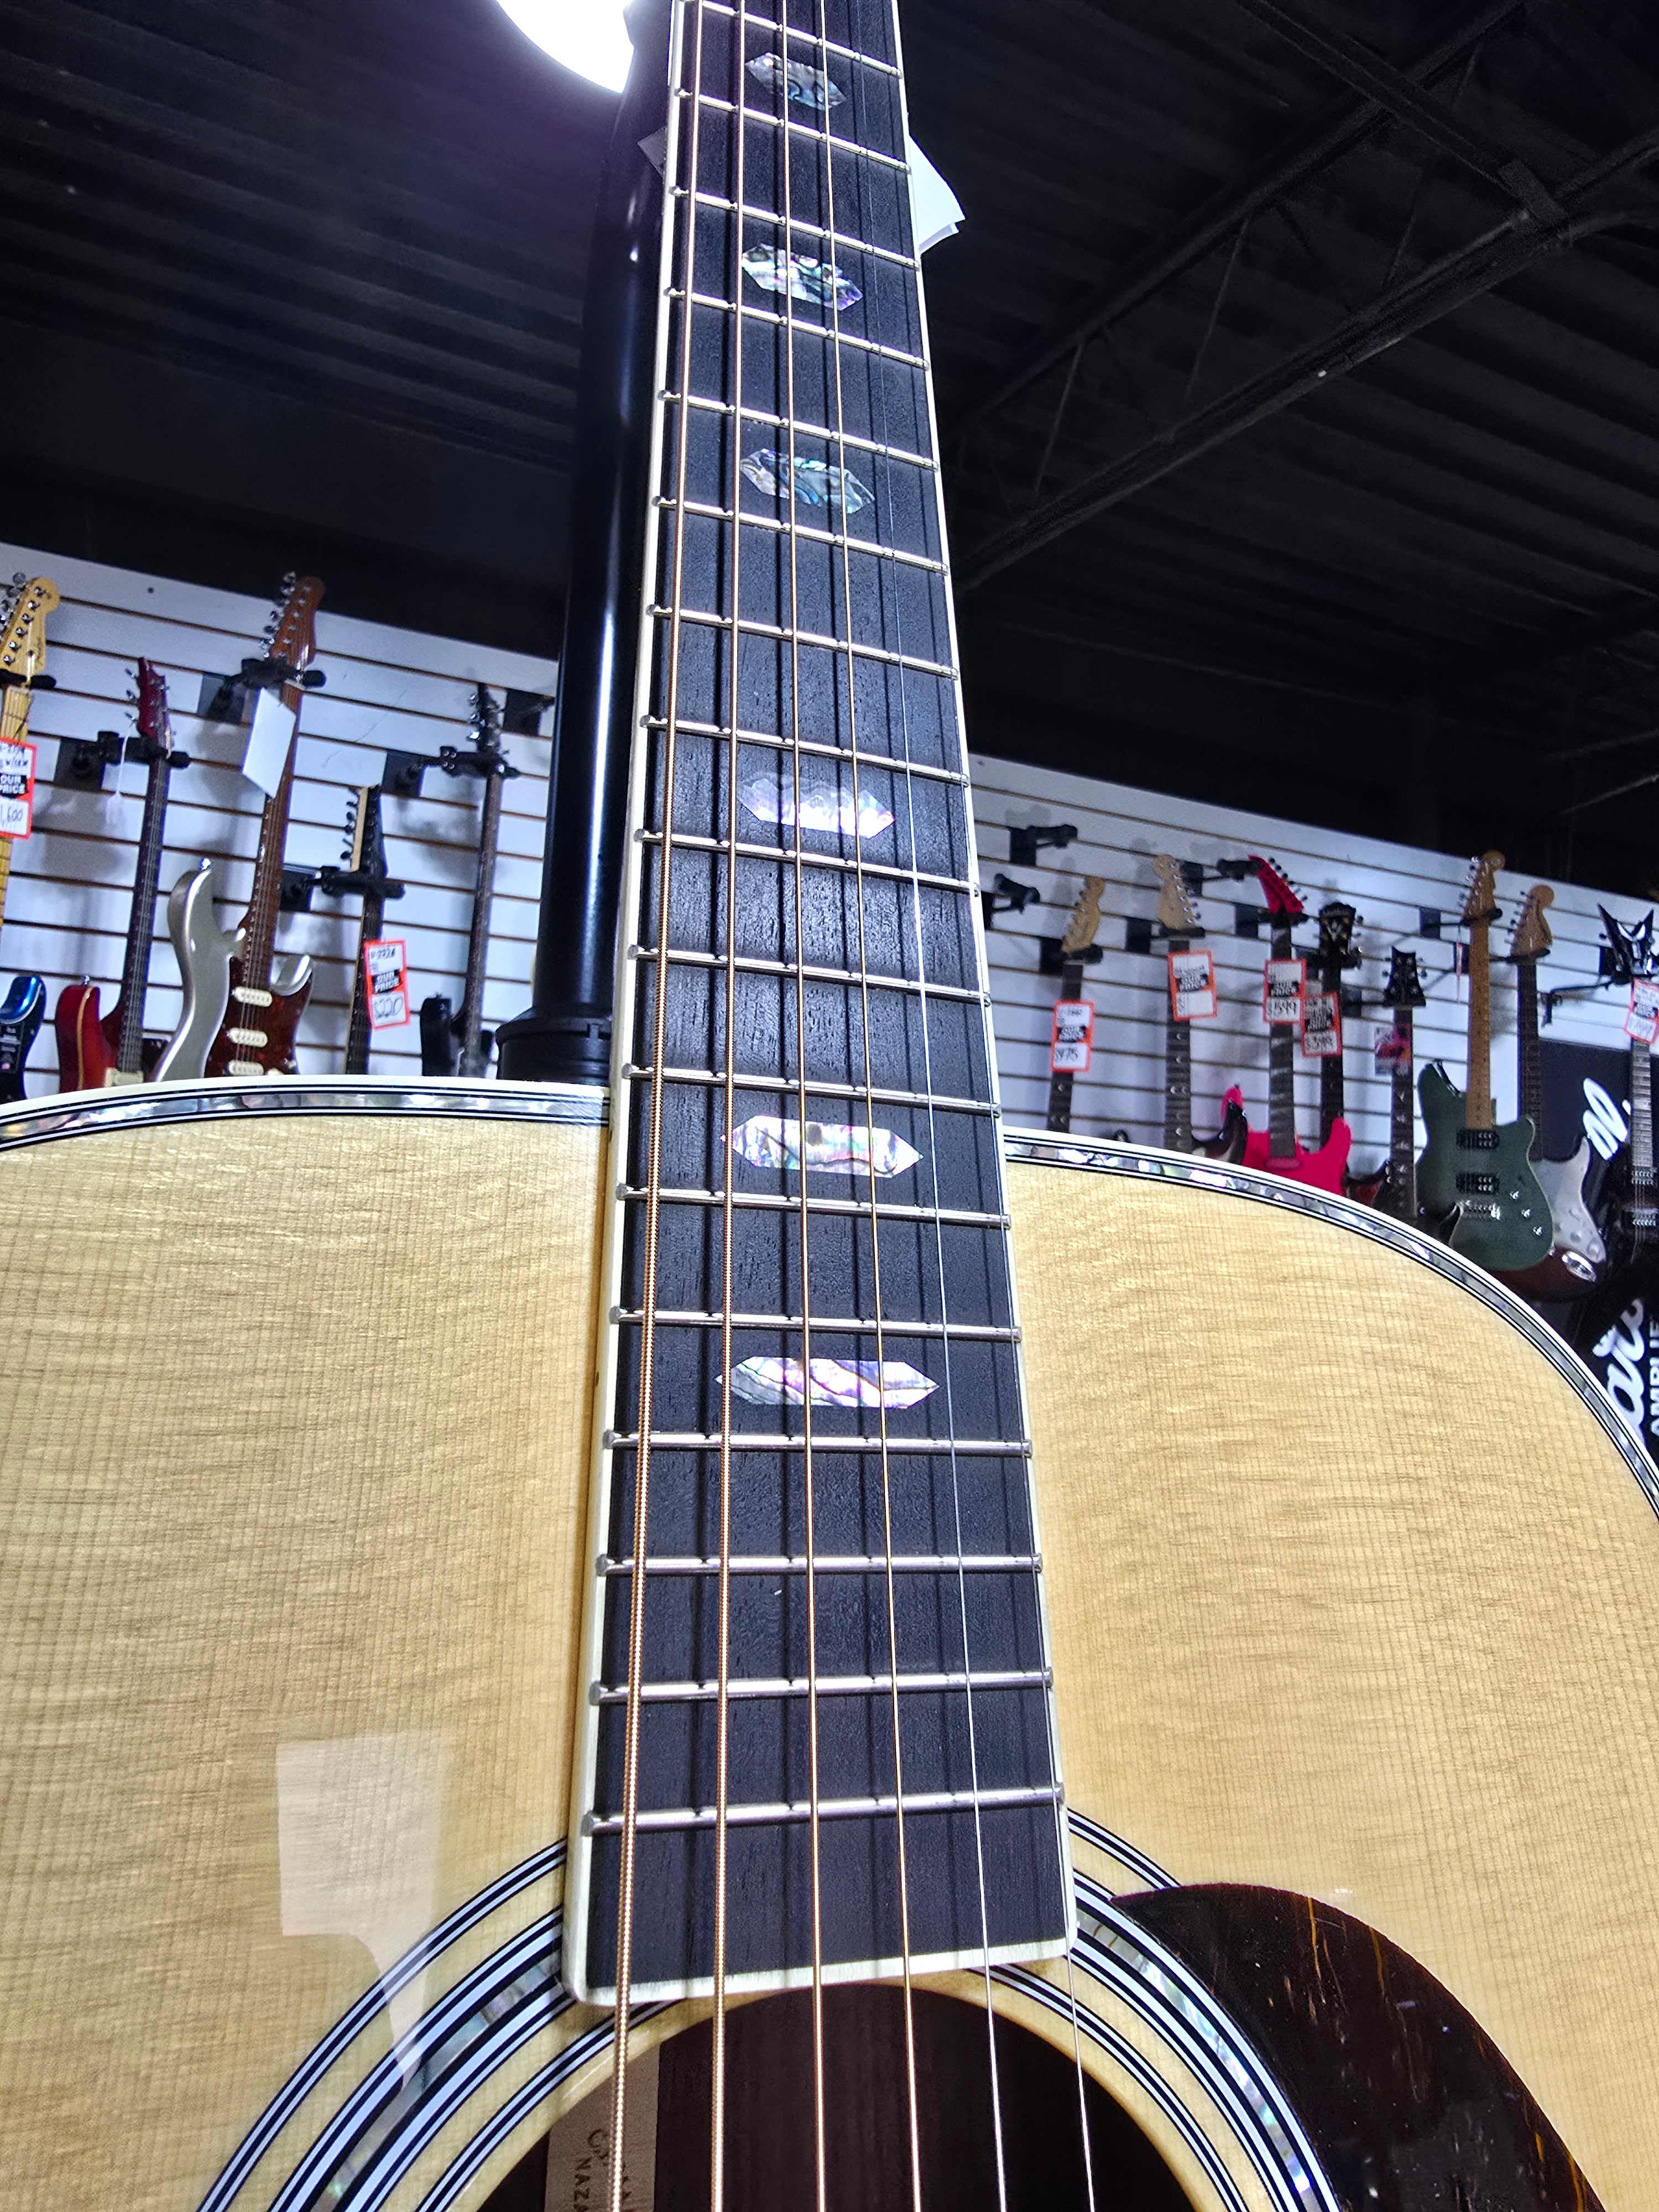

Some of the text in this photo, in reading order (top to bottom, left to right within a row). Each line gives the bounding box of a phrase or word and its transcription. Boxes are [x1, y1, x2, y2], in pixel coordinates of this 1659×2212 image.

[1, 775, 21, 784] OUR
[377, 971, 395, 983] OUR
[375, 977, 400, 993] PRICE
